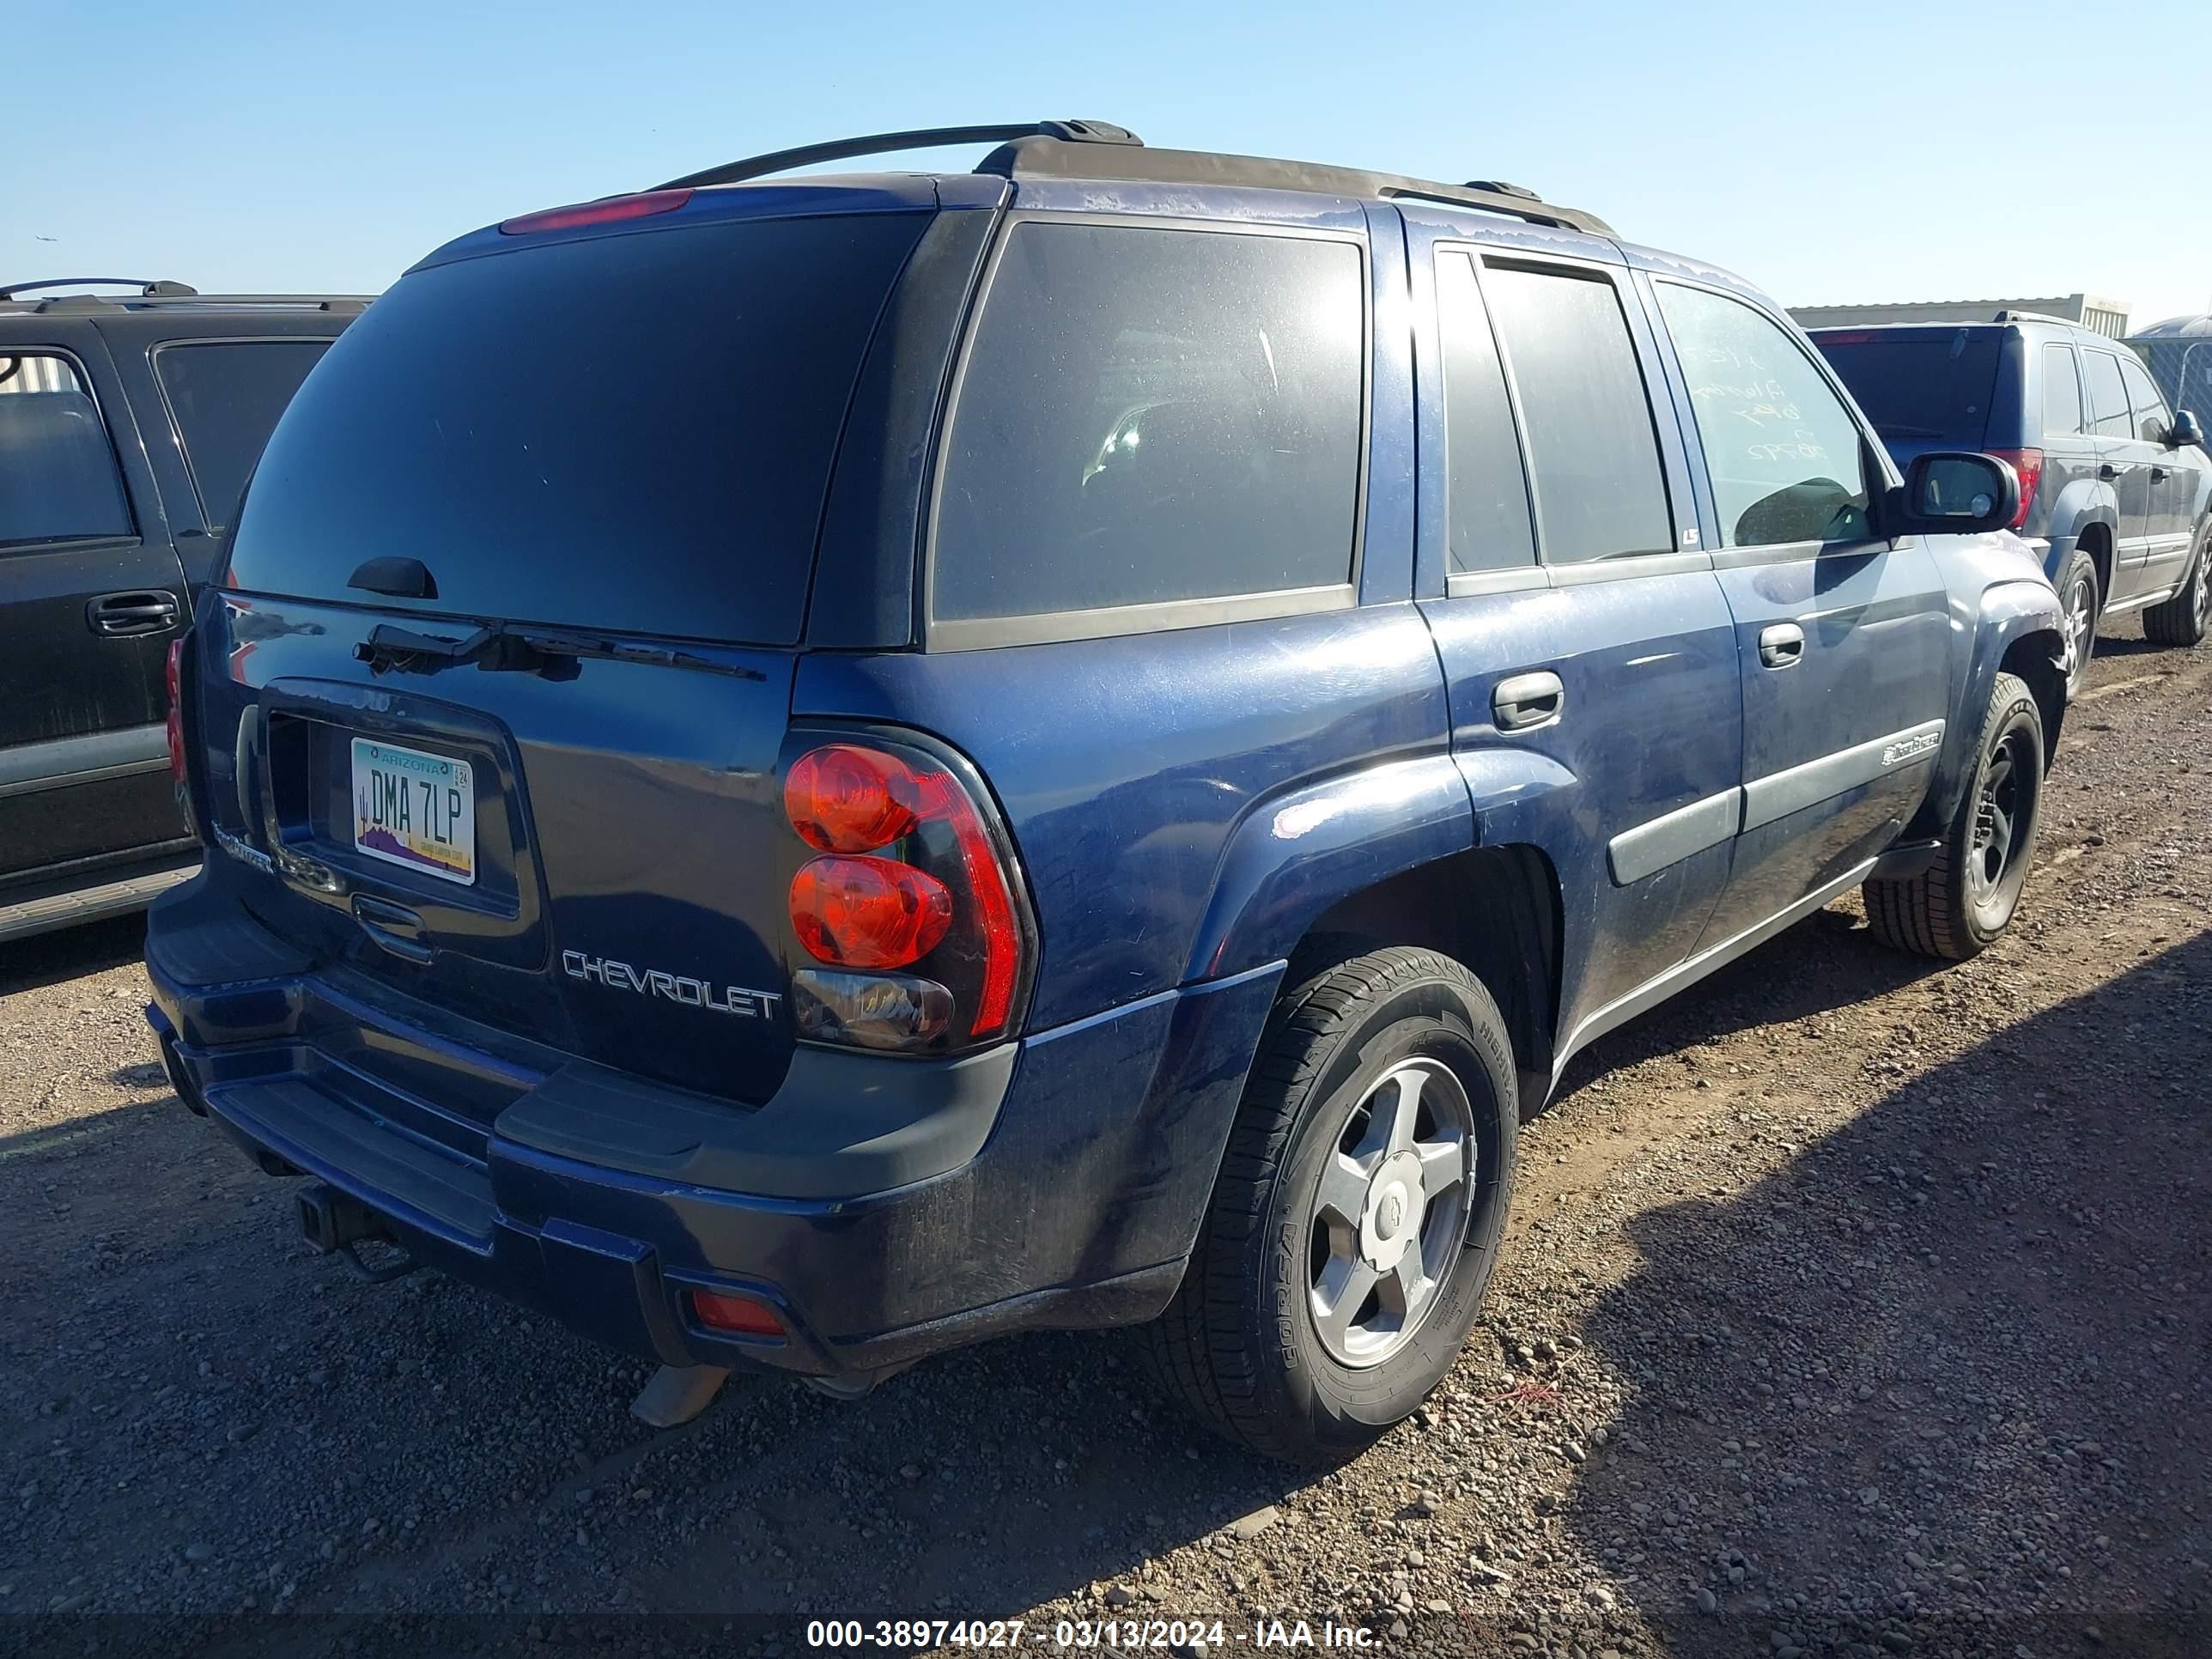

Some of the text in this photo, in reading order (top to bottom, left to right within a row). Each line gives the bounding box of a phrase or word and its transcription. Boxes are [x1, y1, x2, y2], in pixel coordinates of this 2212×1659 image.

[381, 753, 440, 775] ARIZONA
[459, 771, 468, 784] 24
[371, 769, 461, 846] DMA 7LP
[562, 949, 783, 1020] CHEVROLET
[1277, 1222, 1300, 1369] CORSA
